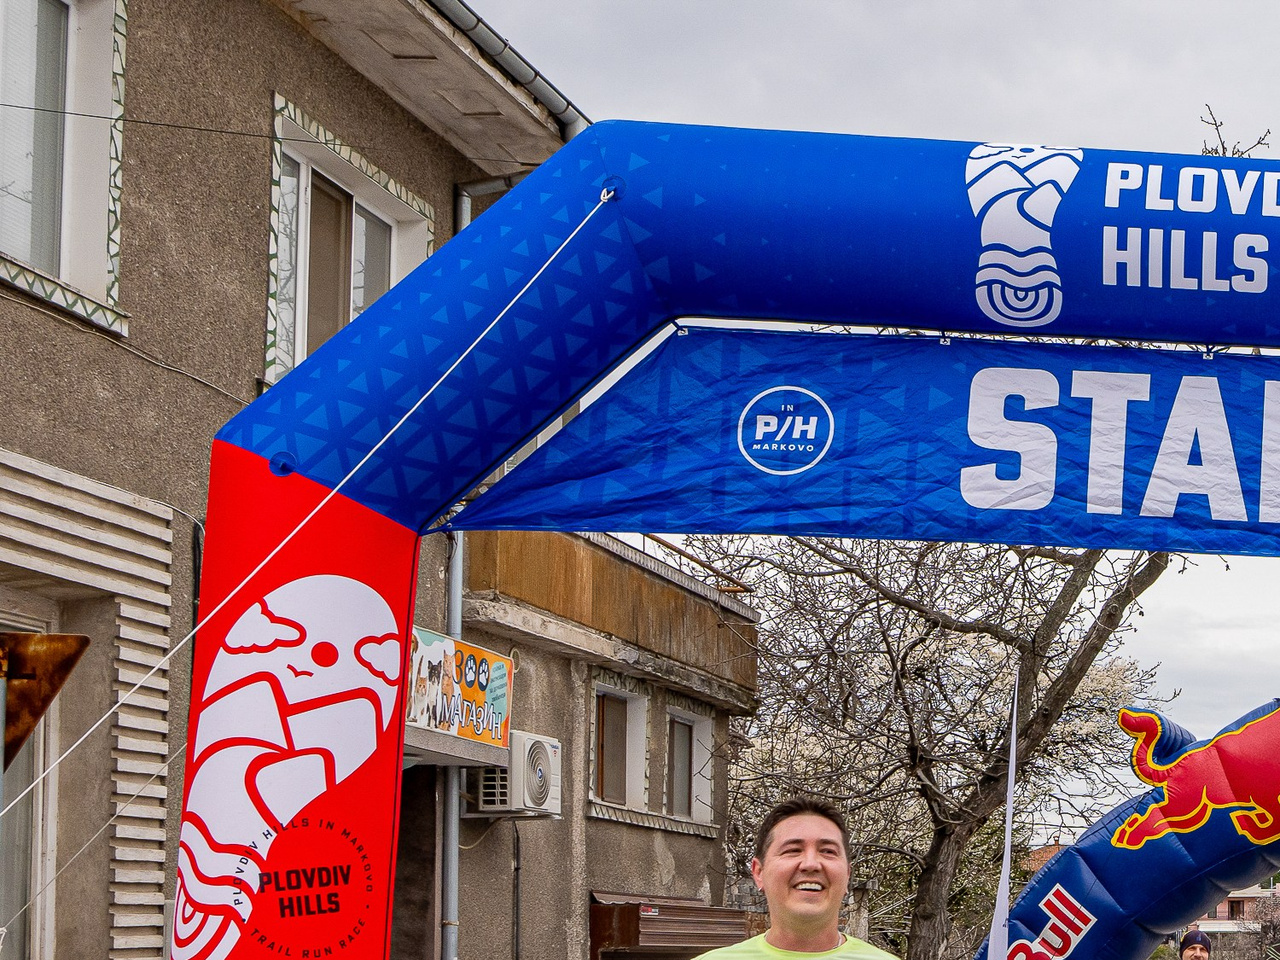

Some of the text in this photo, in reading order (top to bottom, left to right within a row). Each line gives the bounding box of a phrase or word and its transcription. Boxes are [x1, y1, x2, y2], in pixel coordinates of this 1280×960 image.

[1102, 225, 1269, 293] HILLS
[781, 404, 794, 412] IN
[755, 415, 818, 441] P/H
[752, 443, 814, 452] MARKOVO
[440, 693, 502, 740] МАГАЗИН
[233, 818, 373, 906] PLOVDIV HILLS IN MARKOVO
[258, 864, 351, 893] PLOVDIV
[278, 892, 340, 918] HILLS
[250, 918, 366, 959] TRAIL RUN RACE
